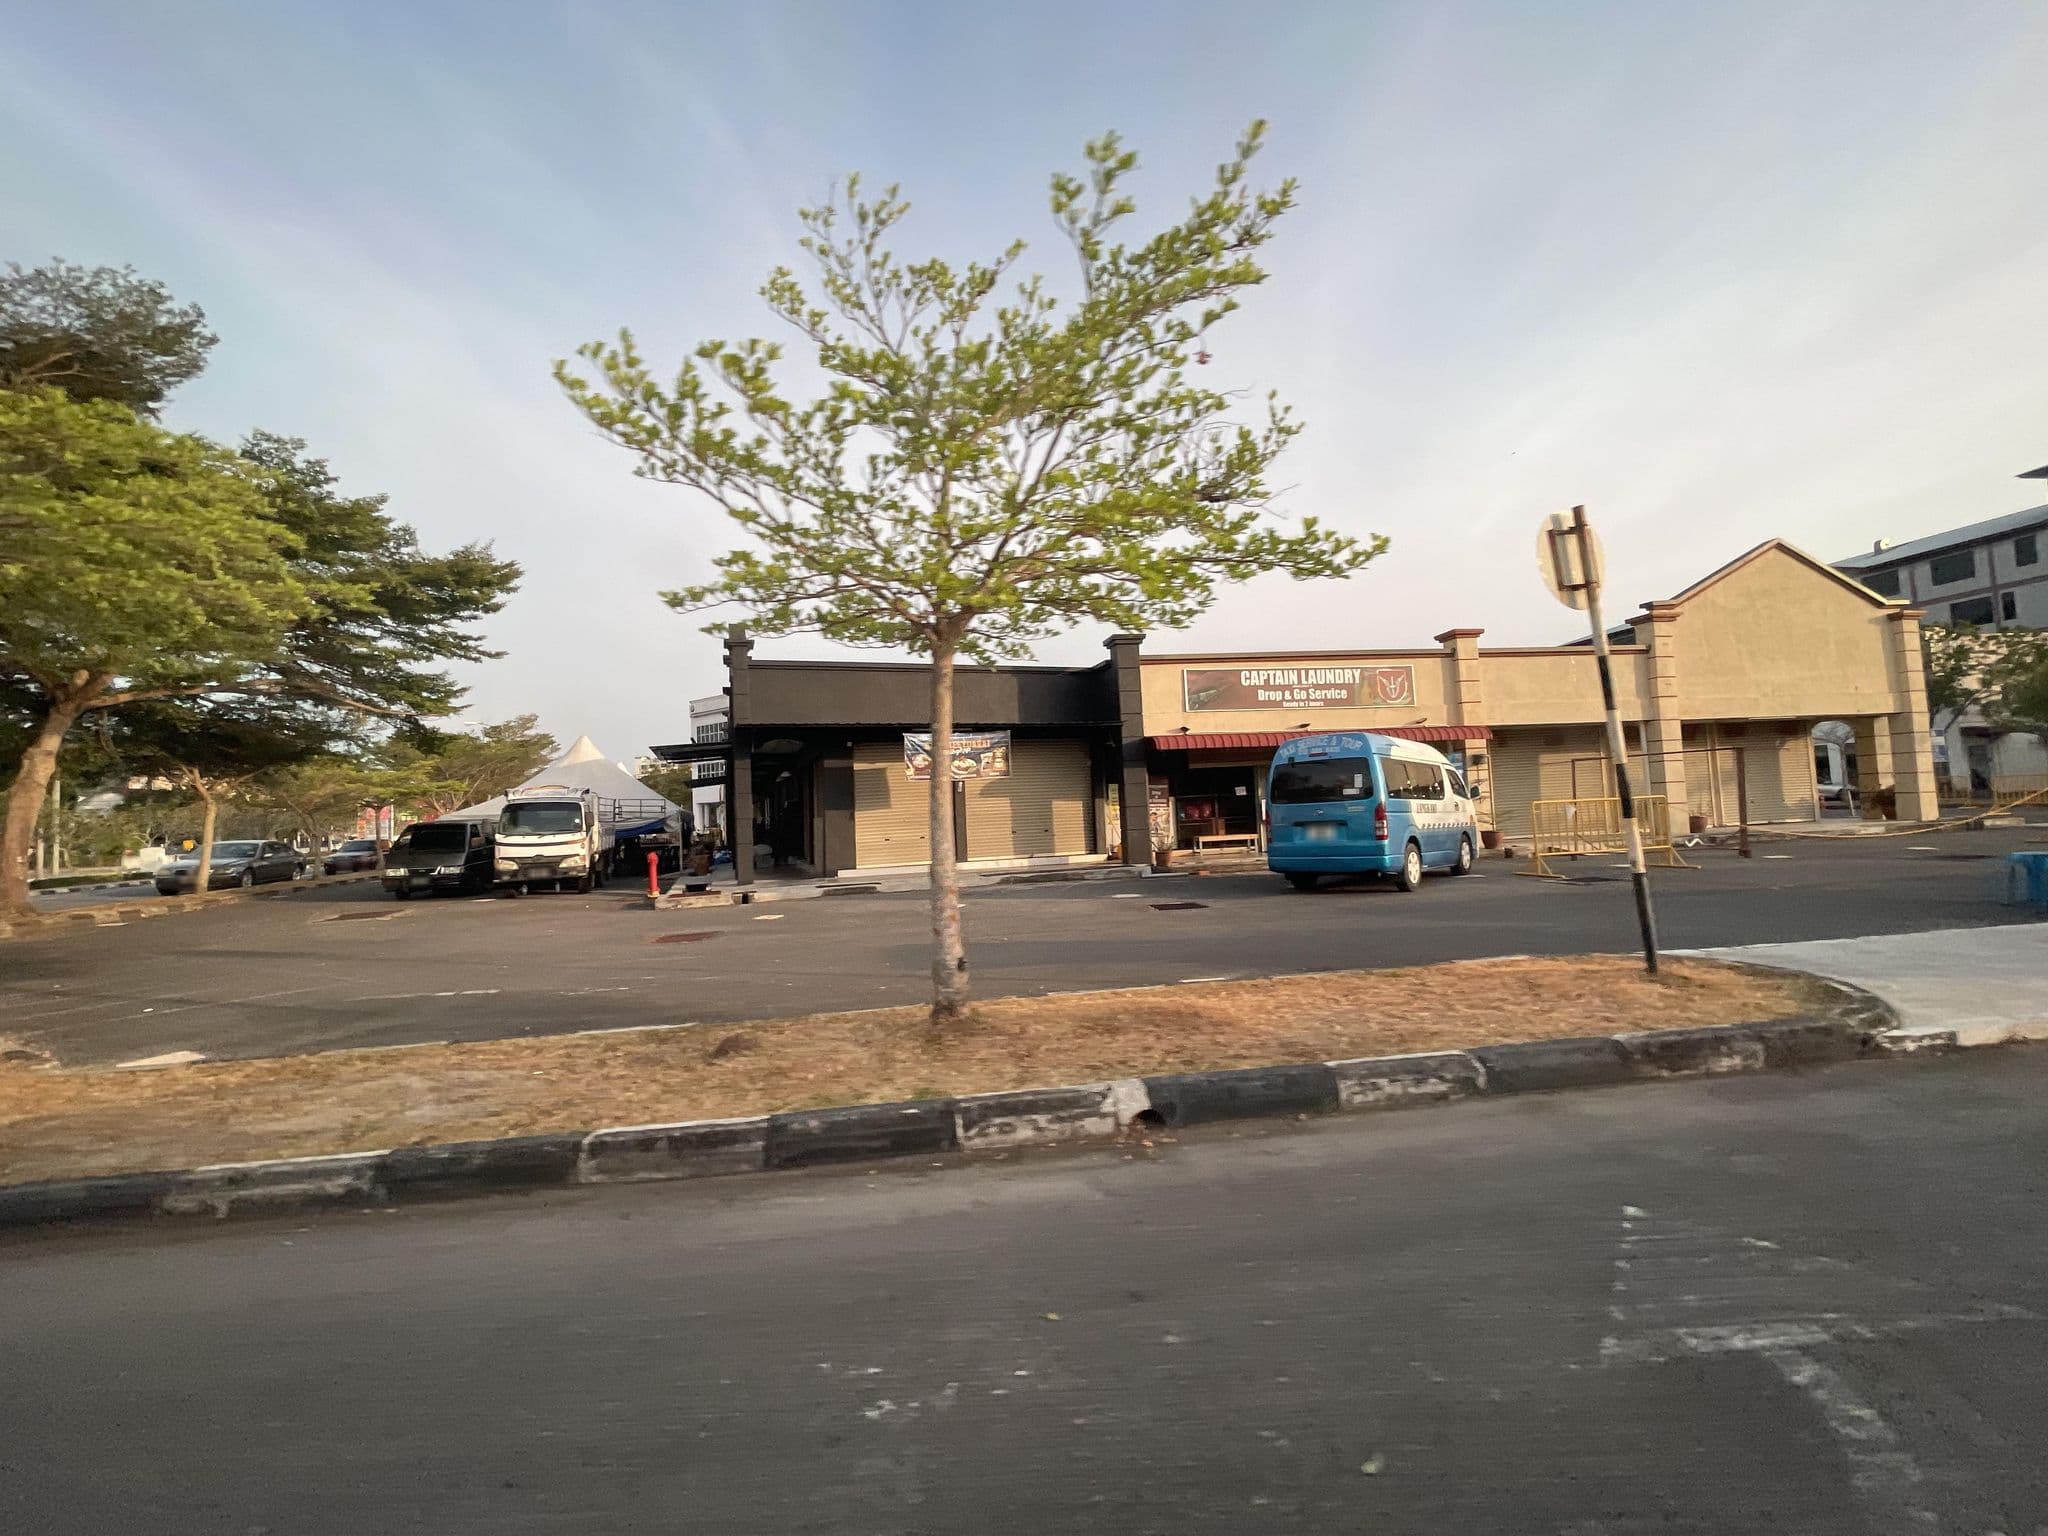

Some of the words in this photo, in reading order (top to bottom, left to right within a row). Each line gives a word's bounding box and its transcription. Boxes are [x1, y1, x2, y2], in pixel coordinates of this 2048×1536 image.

[1240, 669, 1298, 686] CAPTAIN
[1300, 668, 1361, 685] LAUNDRY
[1257, 688, 1282, 702] Drop
[1284, 690, 1292, 700] &
[1293, 688, 1307, 700] Go
[1308, 687, 1348, 700] Service
